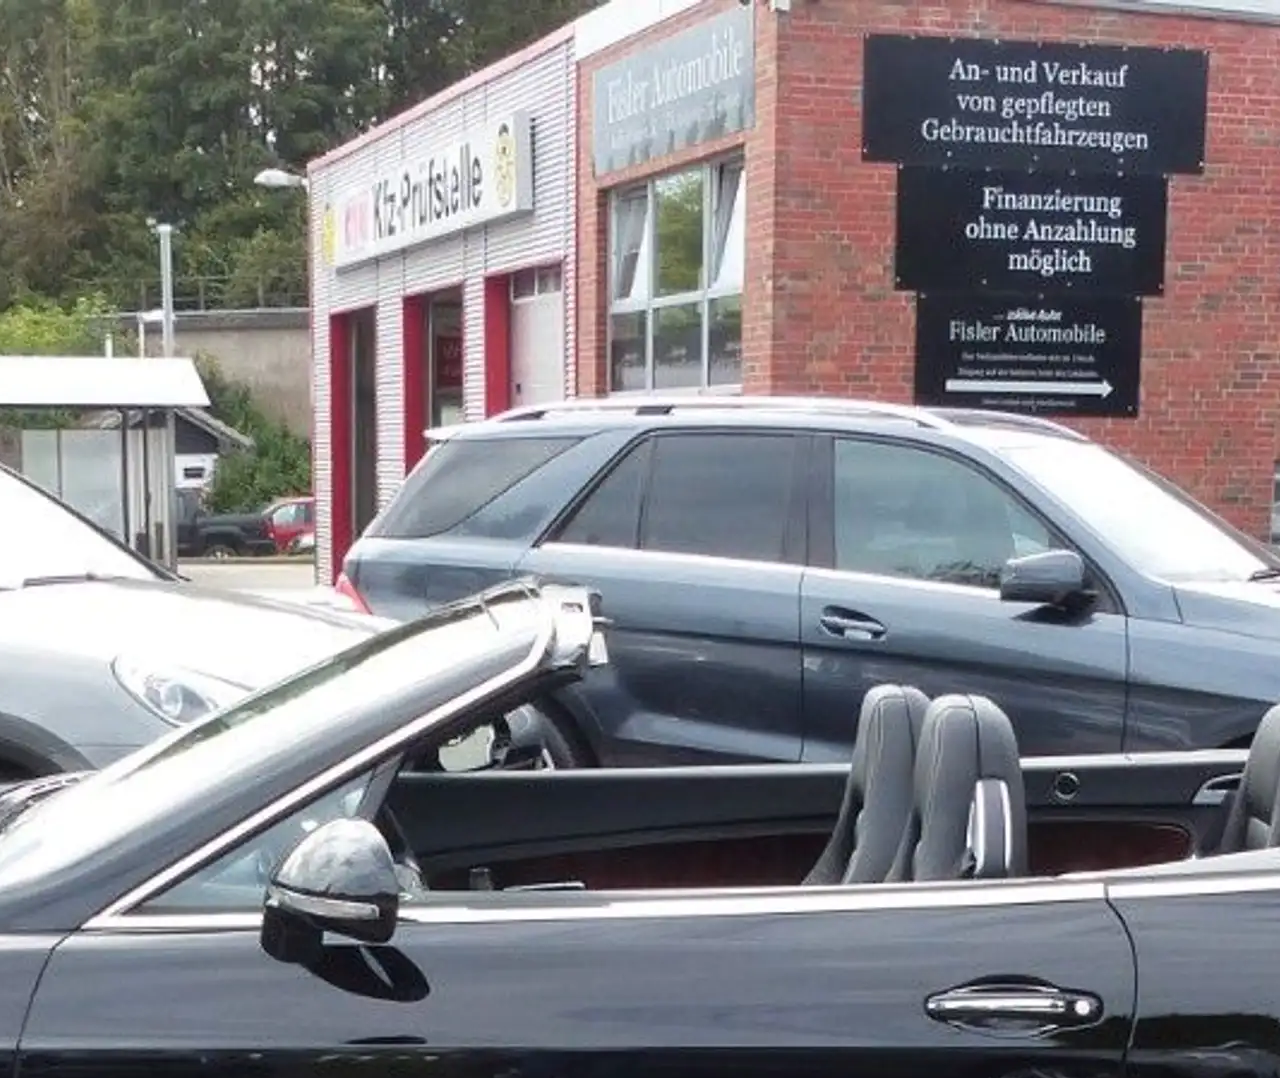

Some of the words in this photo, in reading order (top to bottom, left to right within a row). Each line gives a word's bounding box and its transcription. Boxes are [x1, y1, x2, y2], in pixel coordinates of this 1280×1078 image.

[651, 26, 744, 109] Automobile
[948, 57, 990, 81] An-
[995, 60, 1037, 83] und
[1042, 62, 1129, 87] Verkauf
[956, 93, 996, 112] von
[1001, 91, 1111, 121] gepflegten
[921, 117, 1148, 153] Gebrauchtfahrzeugen
[372, 142, 483, 243] Kfz-Prüfstelle
[982, 186, 1122, 219] Finanzierung
[965, 215, 1019, 239] ohne
[1022, 218, 1136, 248] Anzahlung
[1007, 247, 1092, 276] möglich
[949, 320, 1001, 342] Fisler
[1004, 322, 1106, 344] Automobile
